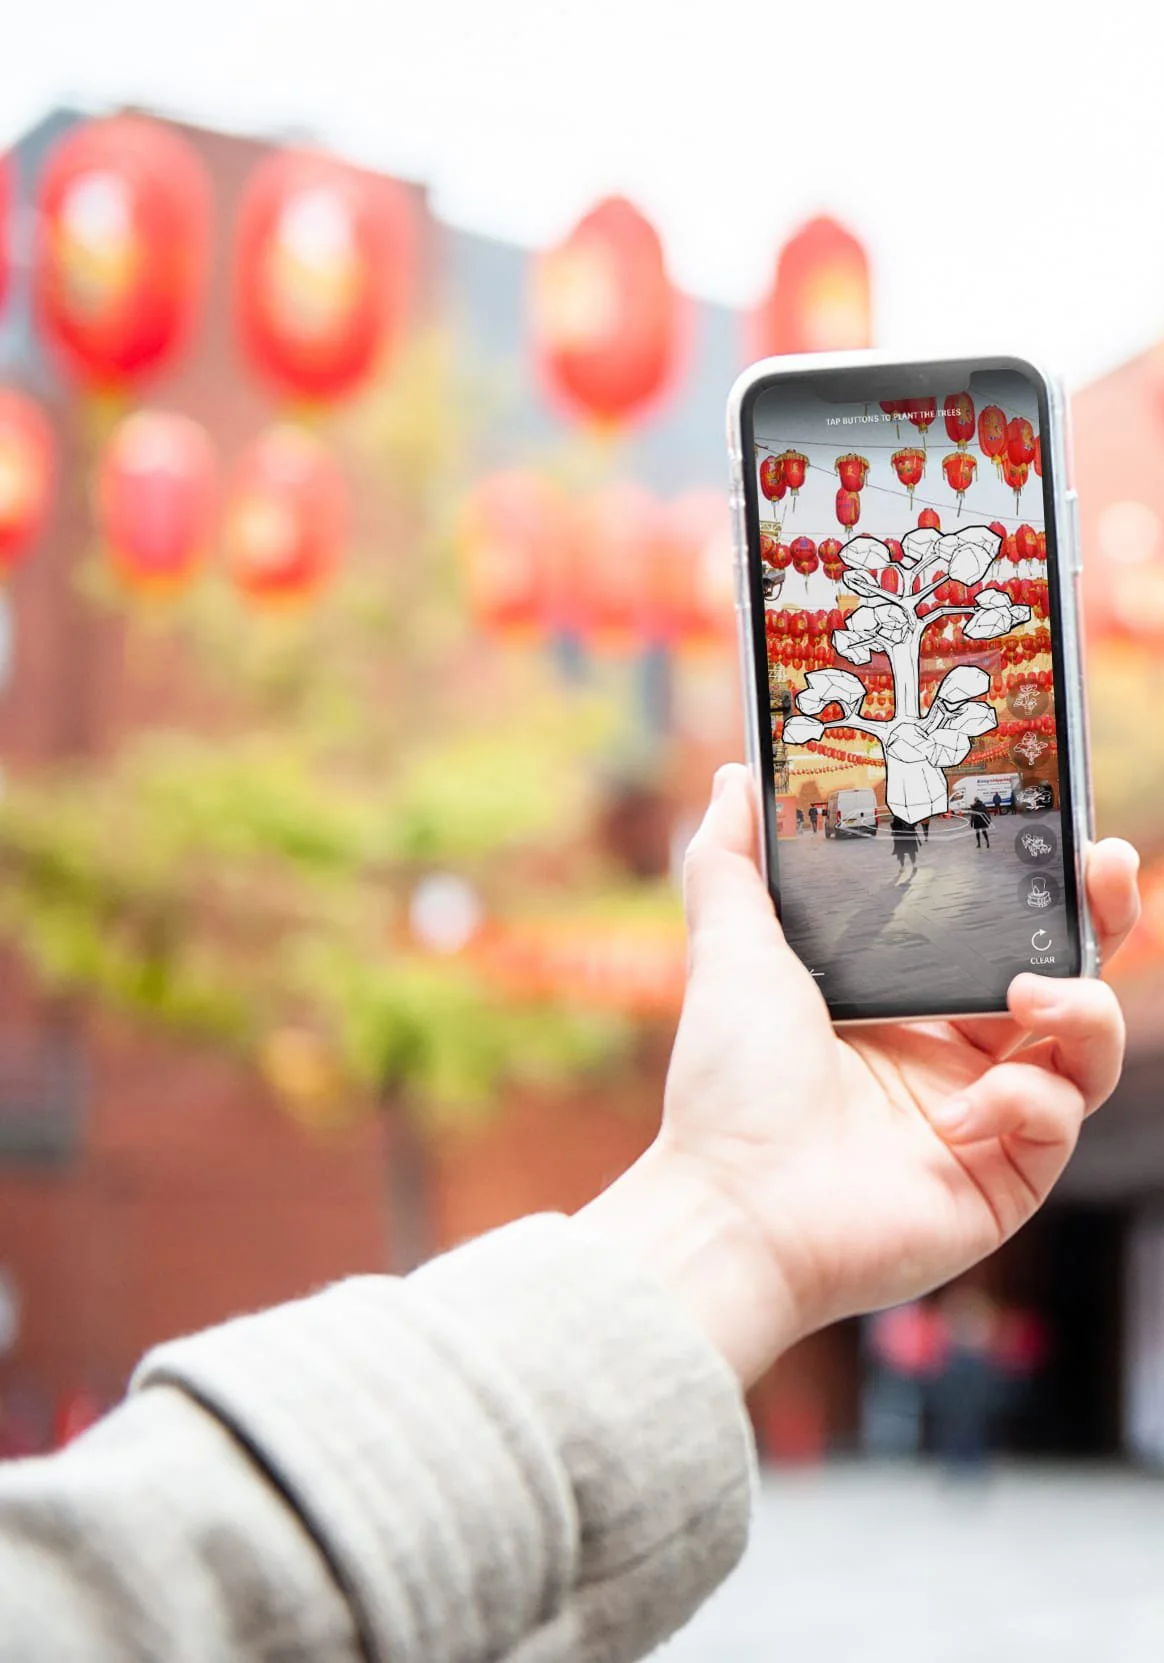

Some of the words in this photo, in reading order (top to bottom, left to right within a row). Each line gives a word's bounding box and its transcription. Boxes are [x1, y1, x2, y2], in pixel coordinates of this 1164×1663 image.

[826, 417, 841, 426] TAP
[842, 415, 879, 425] BUTTONS
[881, 414, 891, 422] TO
[893, 411, 918, 421] PLANT
[920, 410, 935, 419] THE
[937, 408, 961, 417] TREES
[1030, 956, 1055, 965] CLEAR
